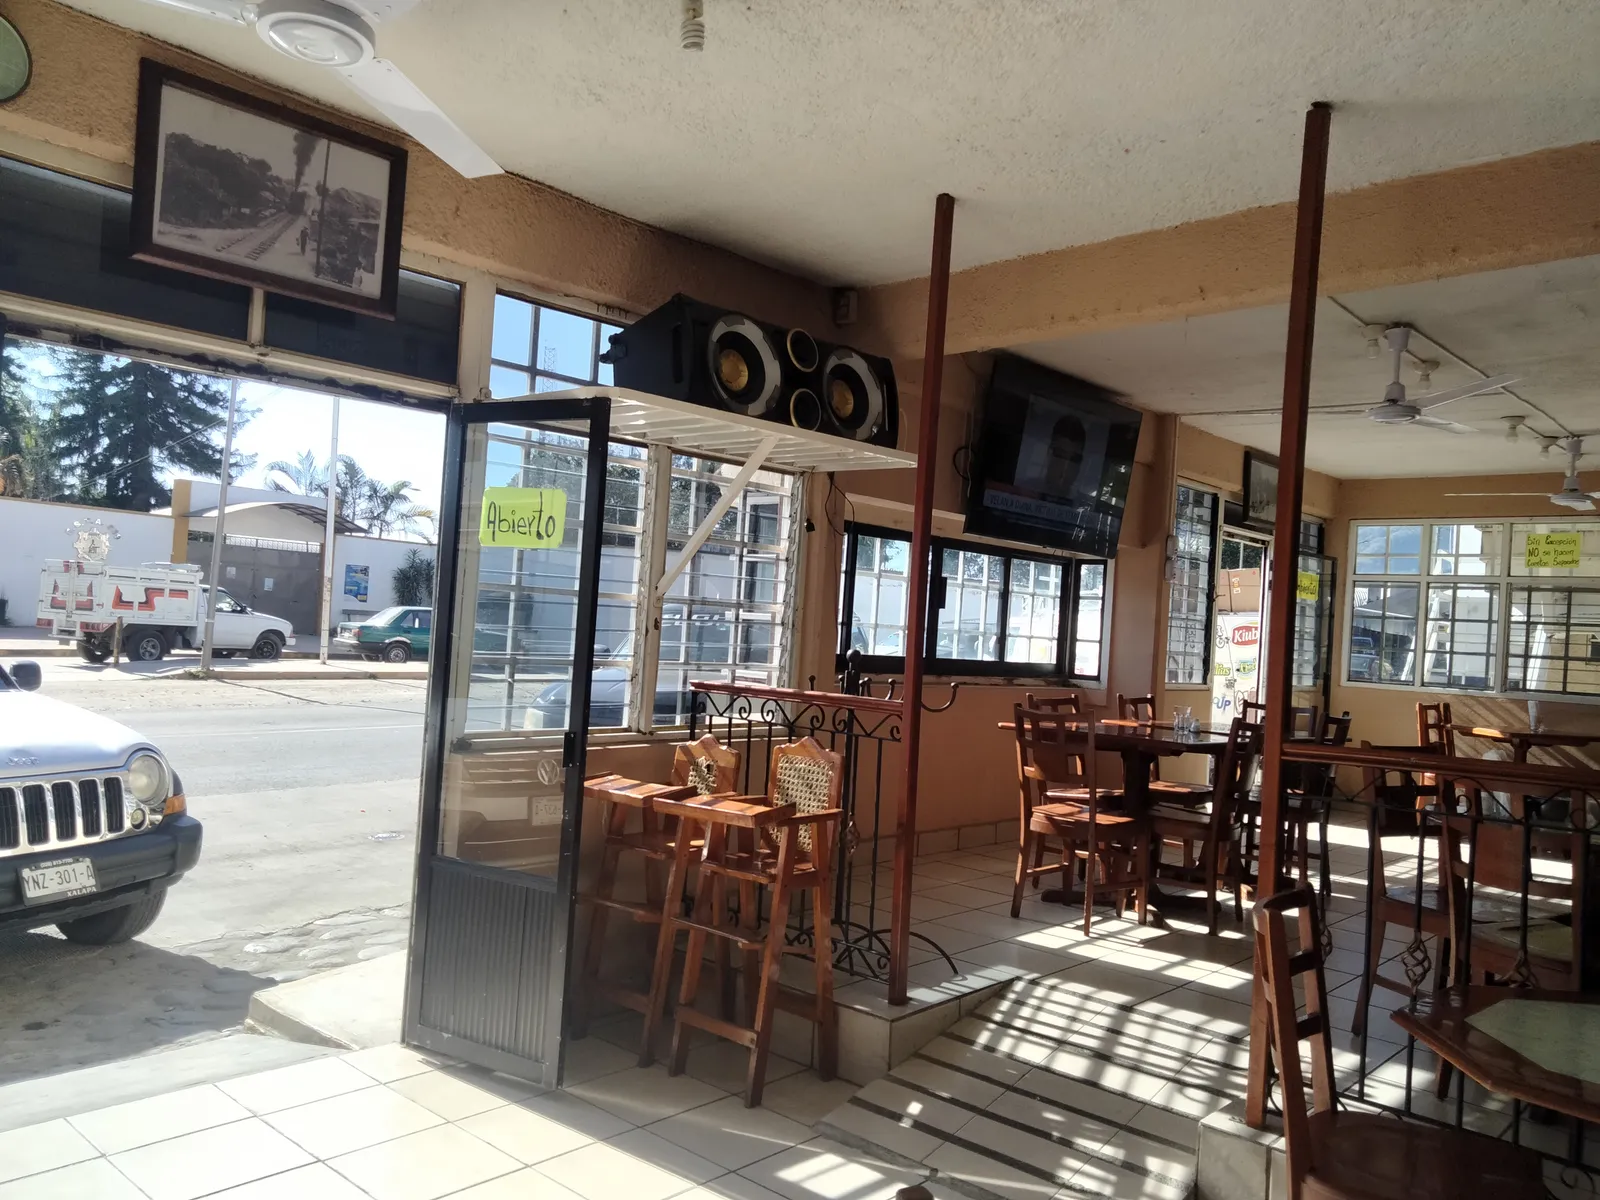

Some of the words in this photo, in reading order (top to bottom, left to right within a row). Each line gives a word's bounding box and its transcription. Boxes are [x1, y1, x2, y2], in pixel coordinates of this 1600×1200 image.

[487, 491, 556, 542] Abierto
[1527, 537, 1541, 546] Sin
[1528, 547, 1540, 558] NO
[1233, 627, 1259, 643] Kiub
[23, 865, 95, 892] YNZ-301-A
[66, 886, 97, 897] XALAPA
